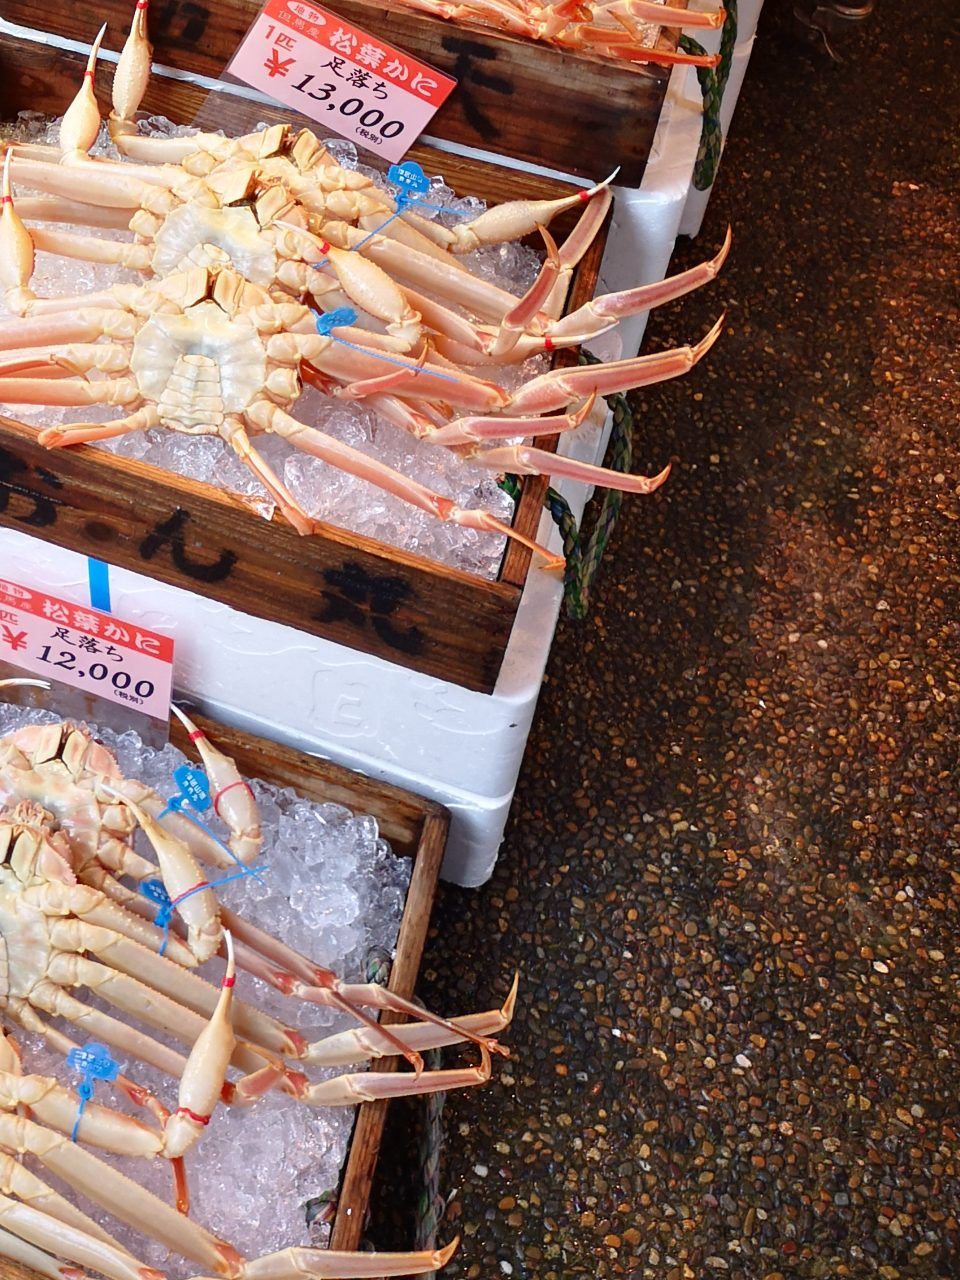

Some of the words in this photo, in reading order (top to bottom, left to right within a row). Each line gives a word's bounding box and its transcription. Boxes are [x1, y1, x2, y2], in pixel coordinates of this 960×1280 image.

[262, 24, 298, 52] 1匹
[328, 27, 438, 97] 松葉かに
[262, 47, 406, 139] ¥13,000
[320, 55, 389, 101] 足落ち
[42, 598, 162, 655] 松葉かに
[50, 626, 124, 663] 足落ち
[0, 624, 156, 700] ¥12,000
